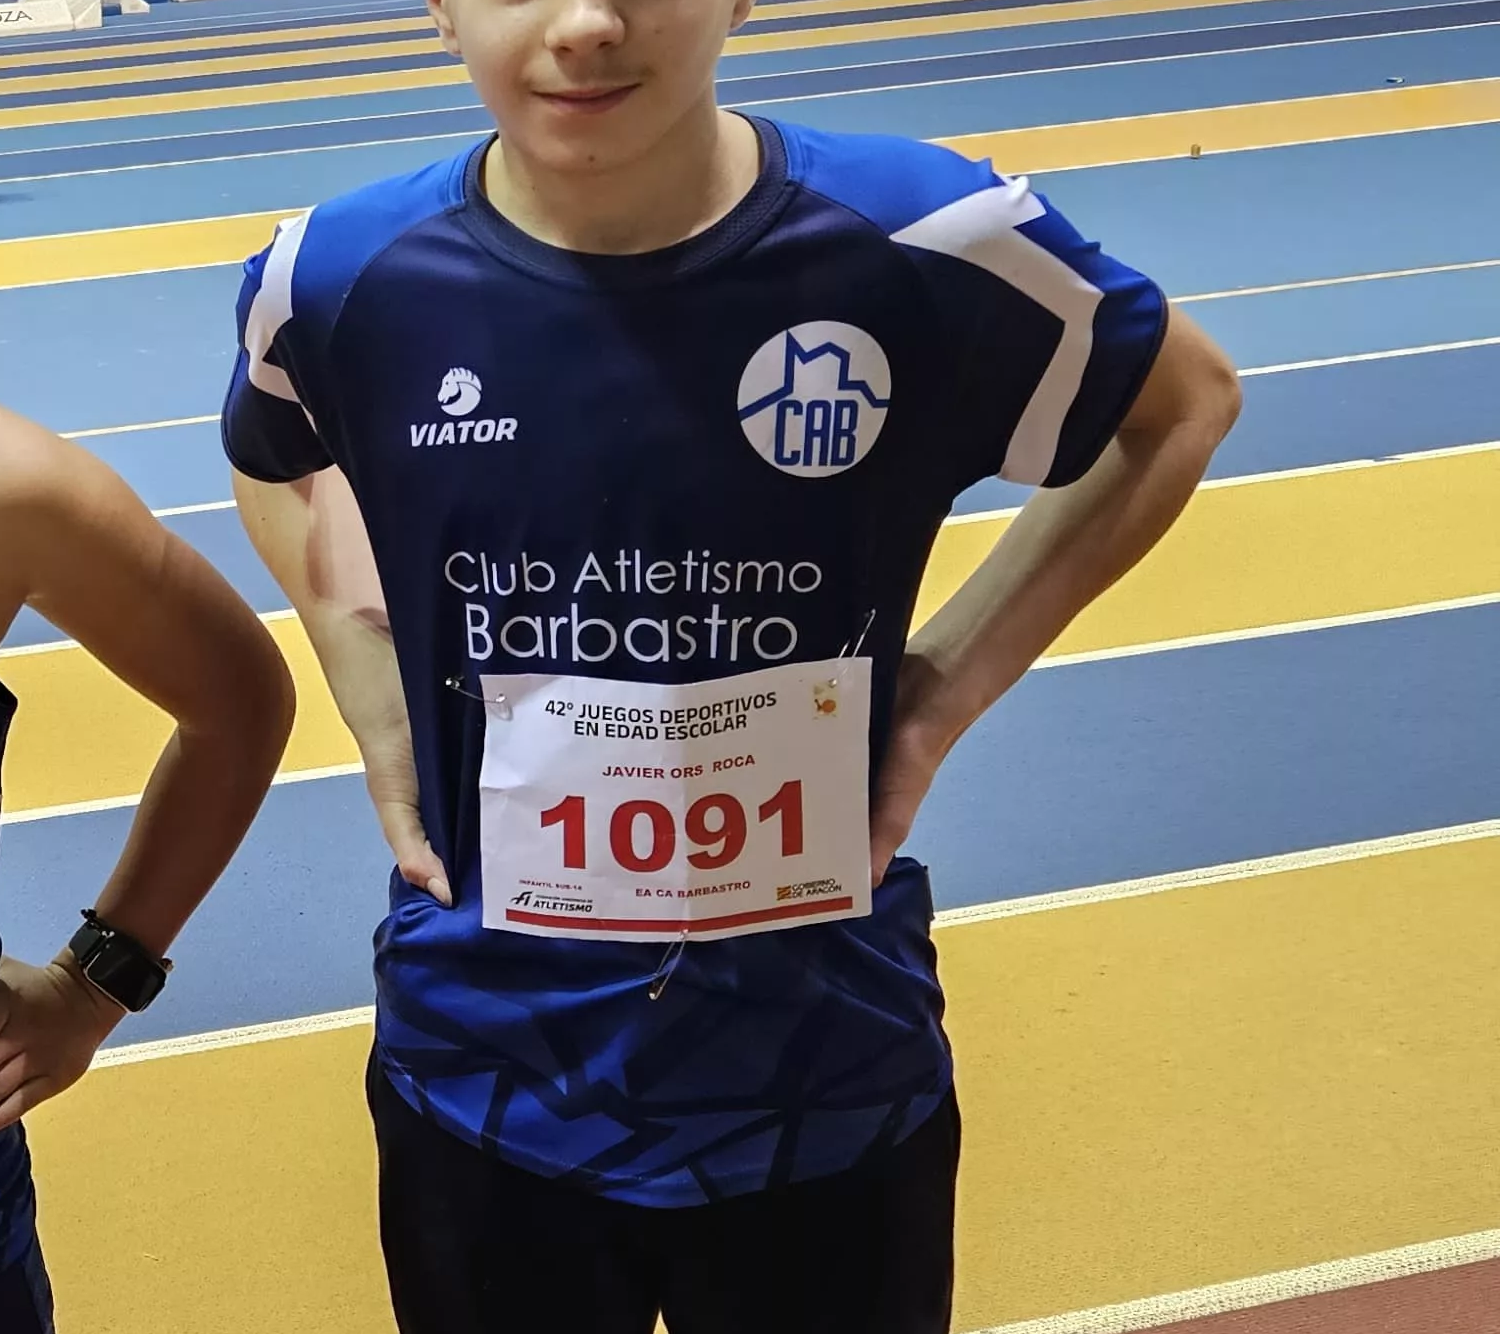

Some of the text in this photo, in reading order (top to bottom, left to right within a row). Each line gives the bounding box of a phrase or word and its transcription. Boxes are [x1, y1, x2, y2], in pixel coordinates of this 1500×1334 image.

[410, 417, 518, 447] VIATOR
[774, 399, 859, 467] CAB
[444, 549, 822, 596] Club Atletismo
[465, 602, 798, 663] Barbastro
[578, 703, 654, 724] JUEGOS
[659, 691, 777, 725] DEPORTIVOS
[574, 713, 747, 741] EN EDAD ESCOLAR
[602, 754, 756, 779] JAVIER ORS ROCA
[540, 779, 803, 873] 1091
[635, 880, 751, 899] EA CA BARBASTRO
[533, 900, 593, 913] ATLETISMO
